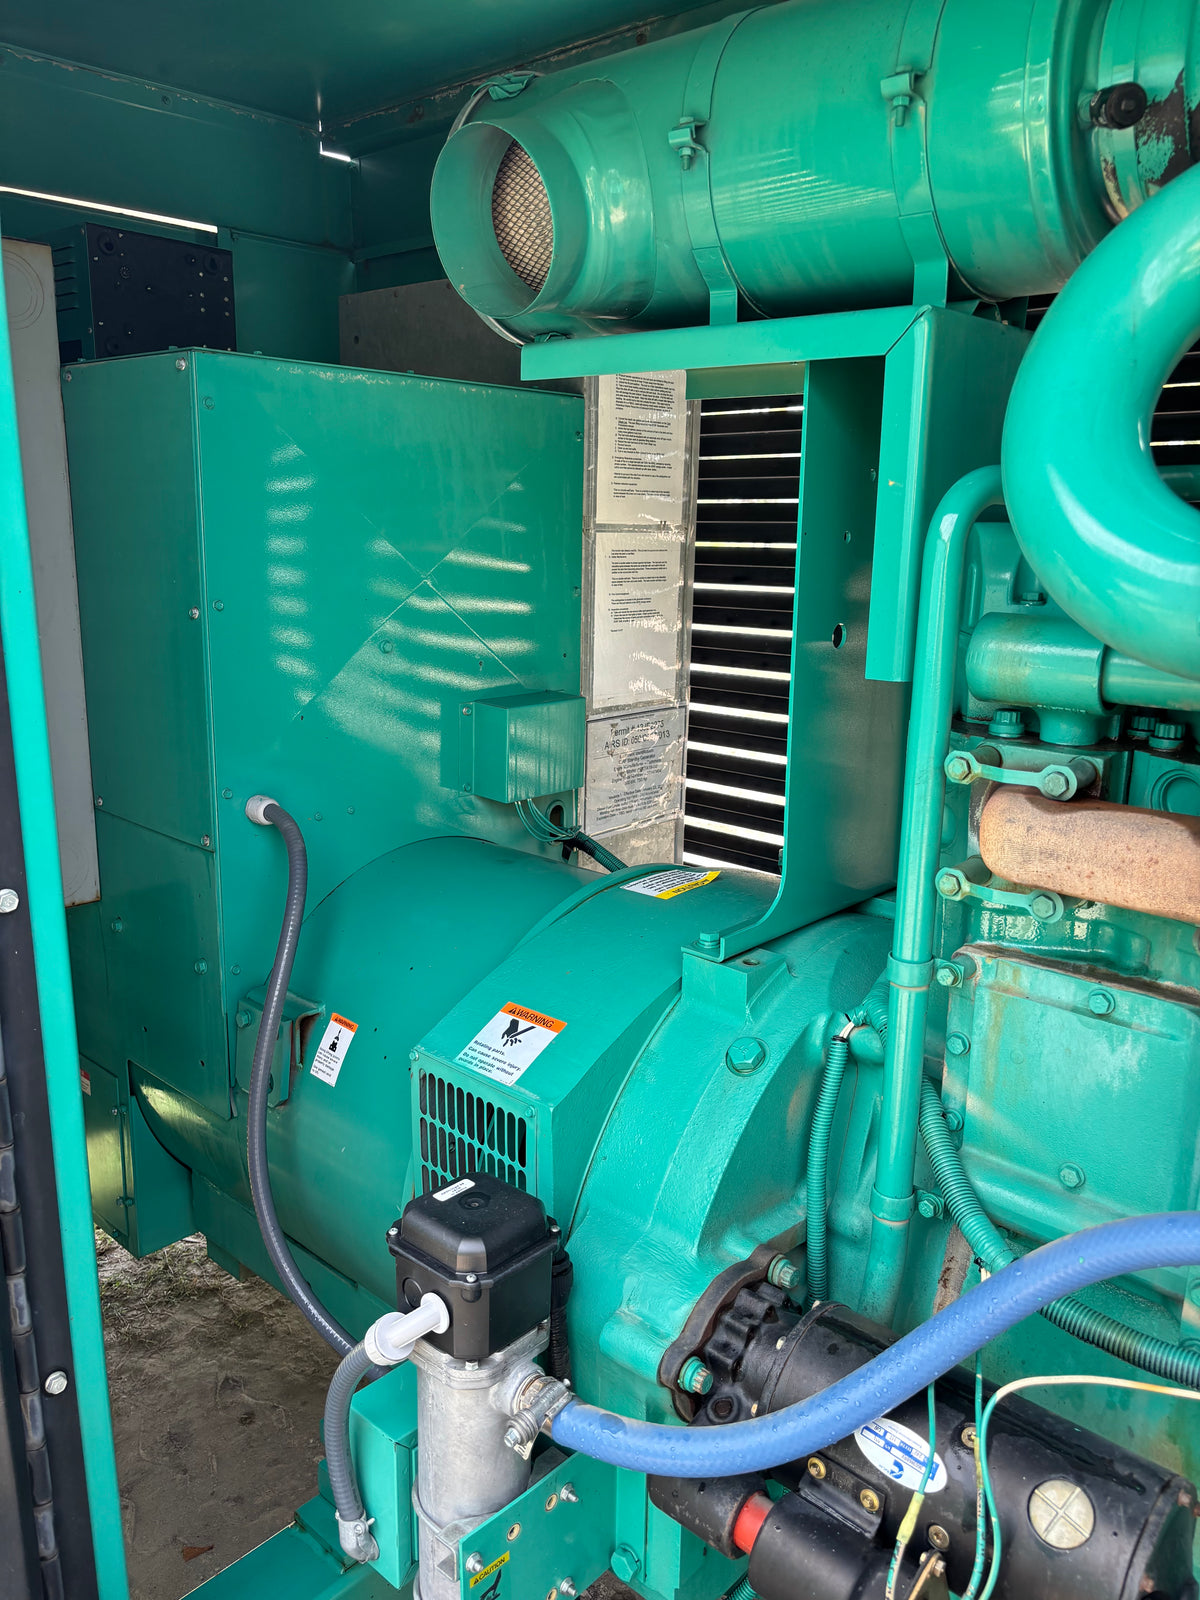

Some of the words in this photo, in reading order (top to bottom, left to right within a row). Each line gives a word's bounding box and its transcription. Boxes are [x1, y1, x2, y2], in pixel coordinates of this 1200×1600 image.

[515, 1007, 555, 1029] WARNING
[468, 1046, 477, 1054] Can
[492, 1056, 507, 1065] severe
[507, 1061, 522, 1072] injury.
[474, 1040, 492, 1052] Rotating
[492, 1048, 506, 1057] parts.
[477, 1058, 496, 1069] operate
[496, 1066, 514, 1077] without
[479, 1557, 506, 1580] CAUTION
